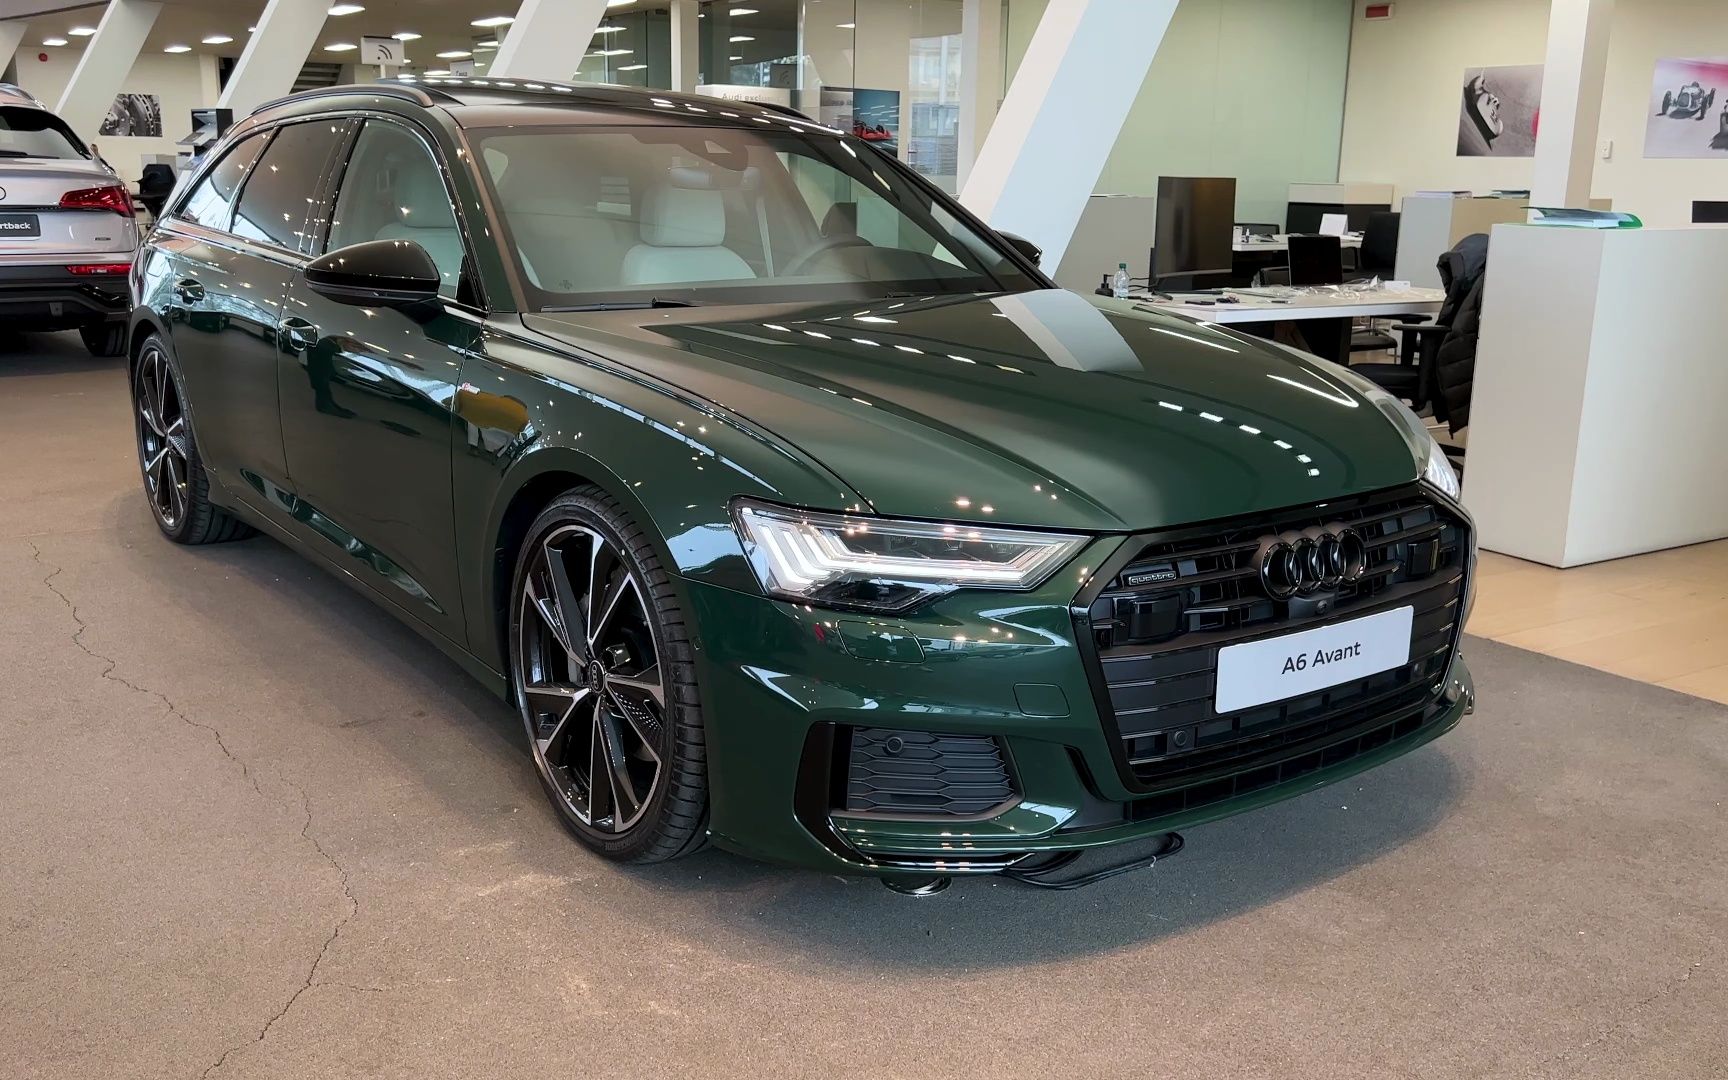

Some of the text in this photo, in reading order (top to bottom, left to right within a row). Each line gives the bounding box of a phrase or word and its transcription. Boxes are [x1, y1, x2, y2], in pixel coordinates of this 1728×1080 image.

[722, 92, 742, 102] Audi
[1130, 572, 1175, 584] quattro
[1281, 641, 1361, 675] A6 Avant
